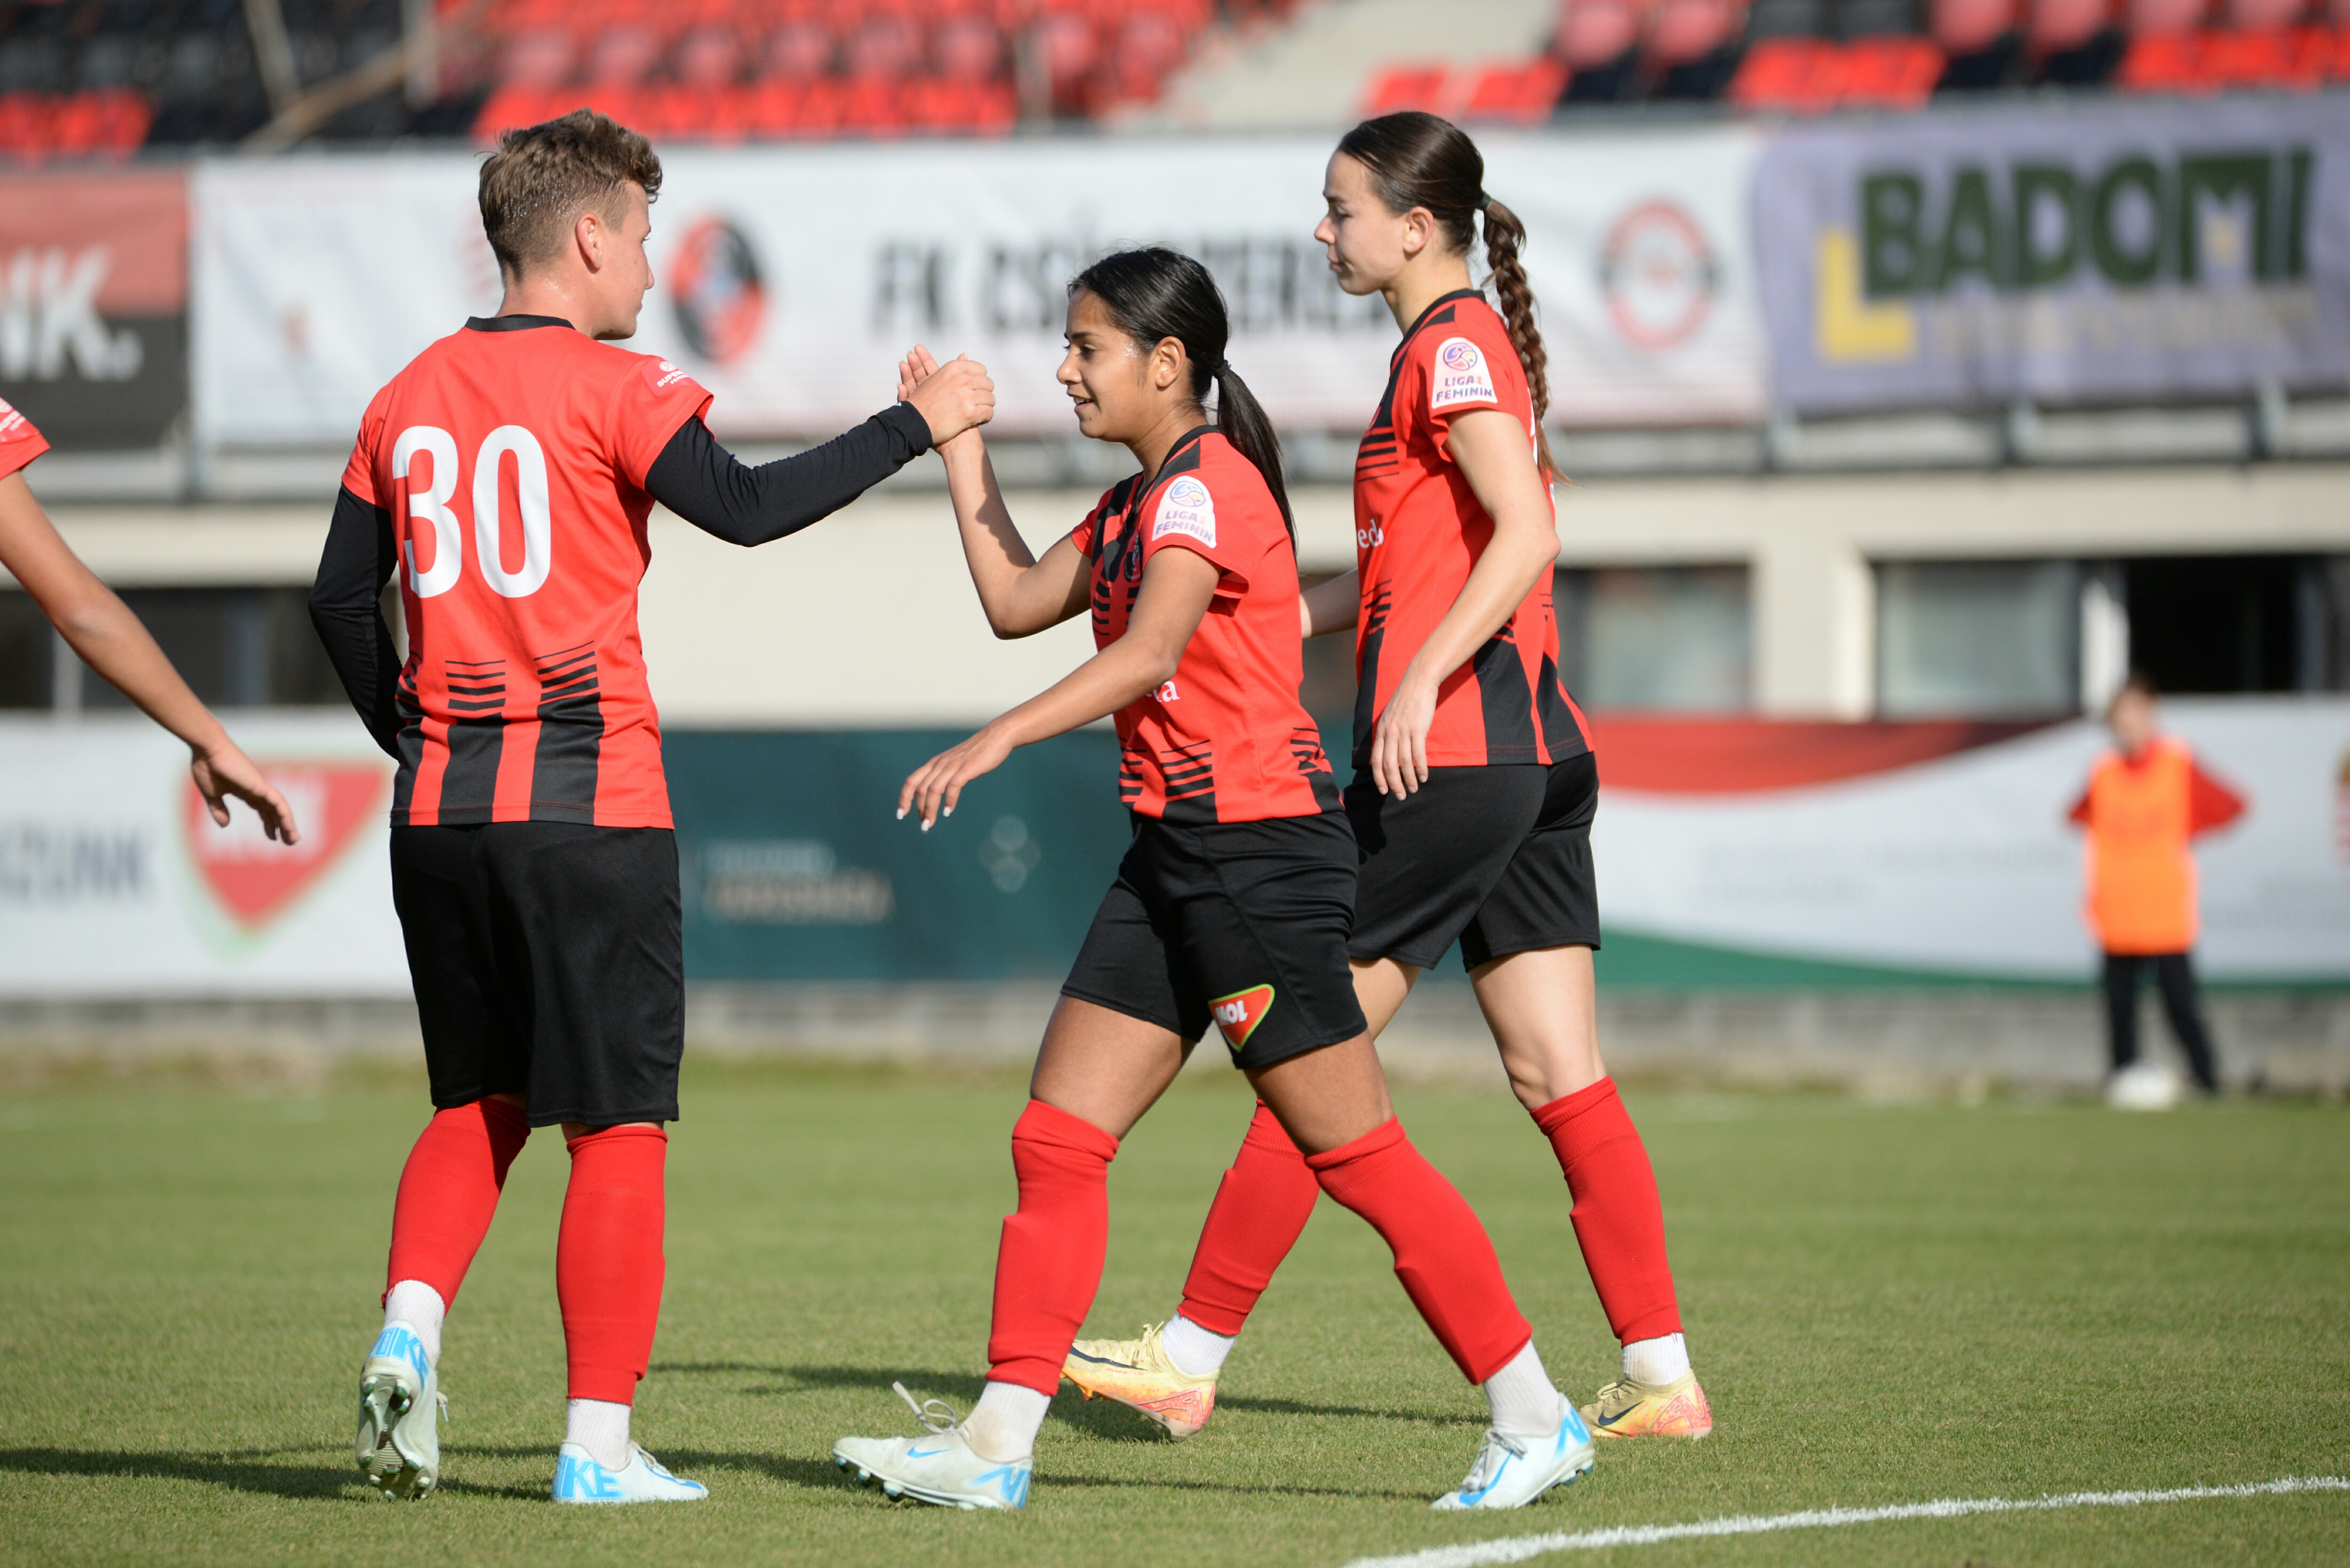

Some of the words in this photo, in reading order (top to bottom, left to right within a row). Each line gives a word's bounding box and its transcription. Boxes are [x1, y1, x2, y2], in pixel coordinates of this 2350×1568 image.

[1860, 145, 2315, 300] BADOMI
[872, 240, 959, 328] FK
[1436, 387, 1492, 402] FEMININ
[392, 425, 551, 598] 30
[1156, 521, 1213, 542] FEMININ
